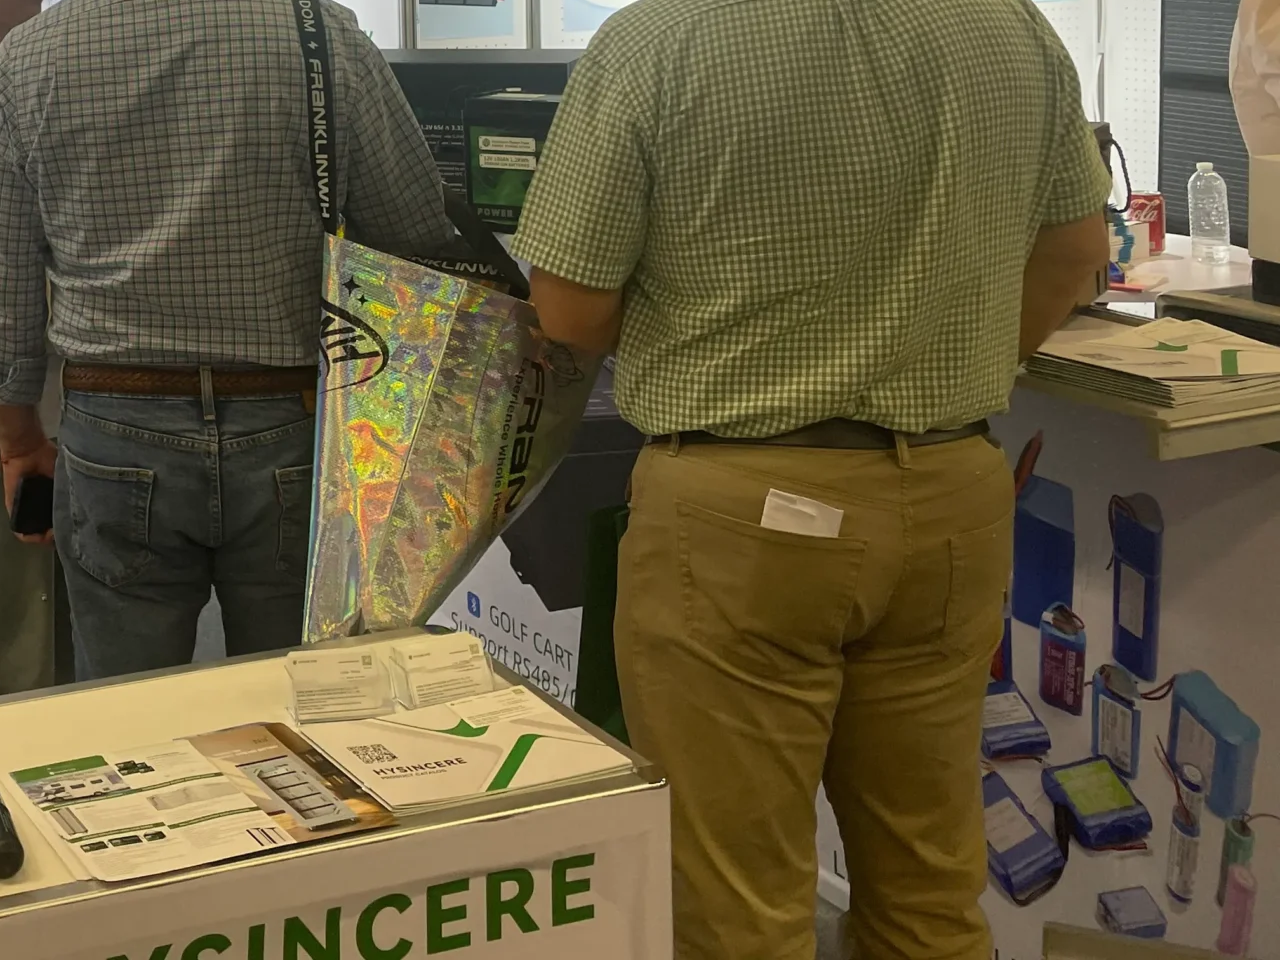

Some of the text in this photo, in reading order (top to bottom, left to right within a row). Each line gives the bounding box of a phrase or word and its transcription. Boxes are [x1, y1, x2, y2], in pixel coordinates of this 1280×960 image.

[495, 358, 530, 488] Experience Whole
[490, 605, 573, 672] GOLF CART
[372, 757, 467, 776] HYSINCERE
